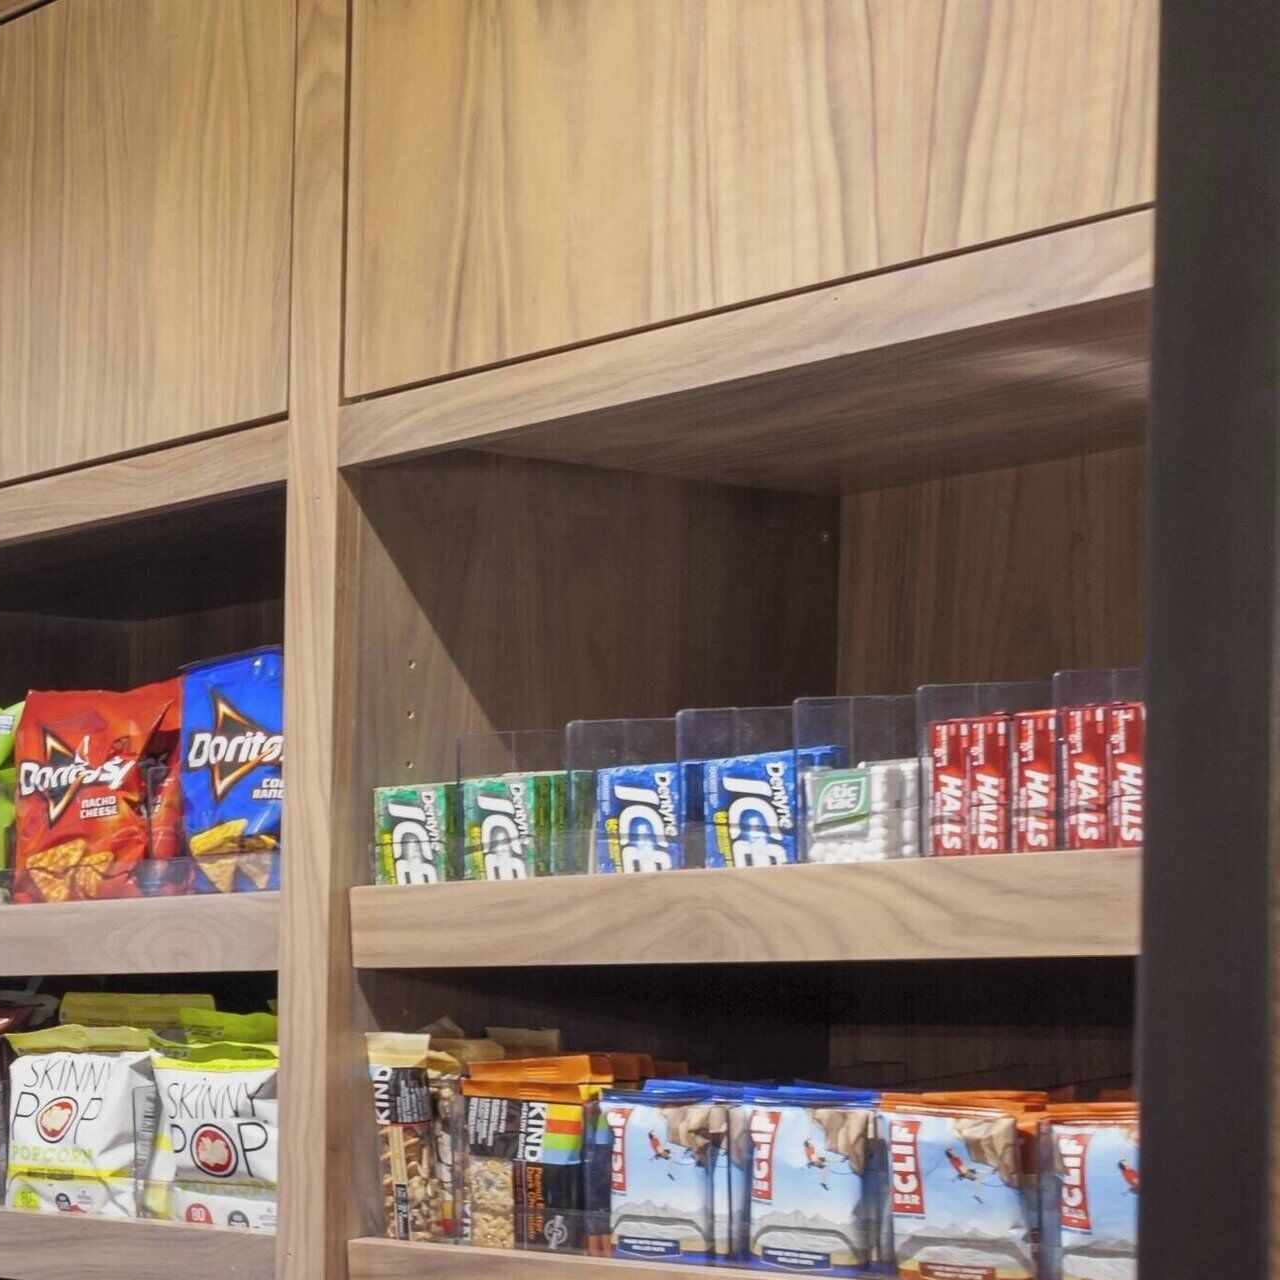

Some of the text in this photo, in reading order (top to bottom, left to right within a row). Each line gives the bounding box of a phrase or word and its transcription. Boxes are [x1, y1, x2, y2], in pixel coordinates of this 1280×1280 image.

[80, 805, 118, 818] CHEESE
[82, 796, 116, 806] NACHO
[654, 772, 678, 837] Dentyne
[766, 761, 792, 828] Dentyne
[976, 773, 999, 850] HALLS
[1024, 770, 1050, 847] HALLS
[1116, 762, 1143, 841] HALLS
[12, 1092, 103, 1145] POP
[374, 1069, 391, 1125] KIND
[524, 1102, 547, 1162] KIND
[891, 1122, 920, 1193] CLIF
[1061, 1135, 1087, 1206] CLIF
